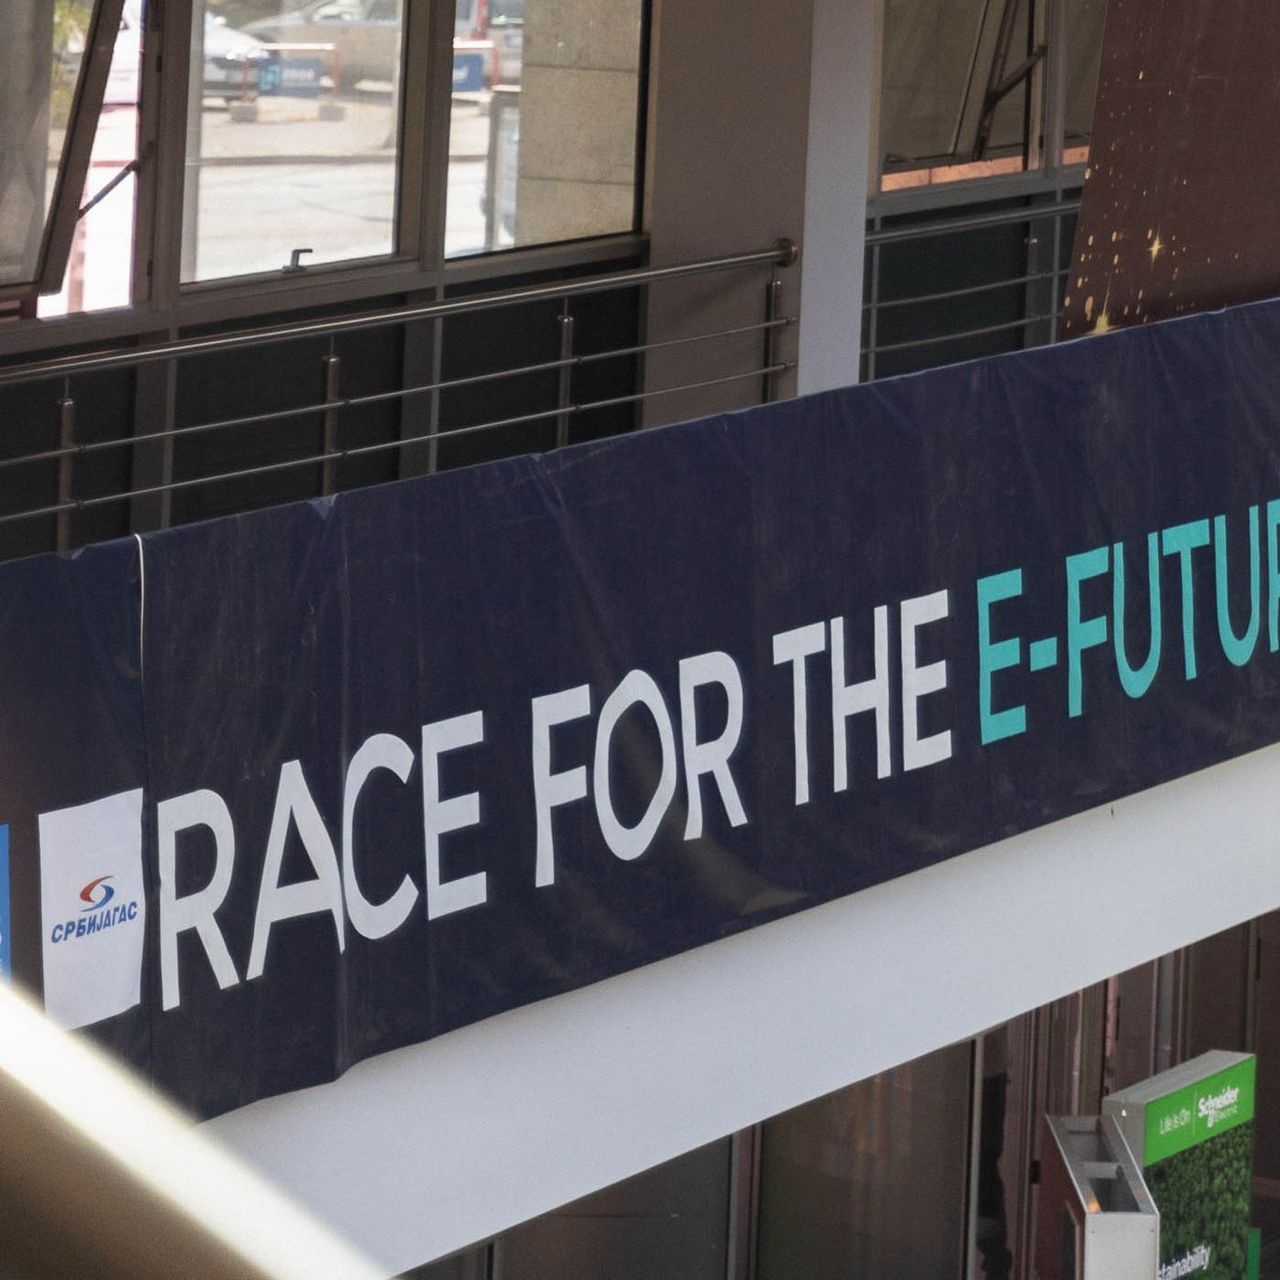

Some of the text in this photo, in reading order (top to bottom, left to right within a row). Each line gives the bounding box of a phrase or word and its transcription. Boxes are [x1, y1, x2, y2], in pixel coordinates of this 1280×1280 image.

[157, 710, 488, 1011] RACE
[532, 651, 748, 888] FOR
[772, 589, 953, 805] THE
[51, 901, 138, 944] СРБИЈАГАС
